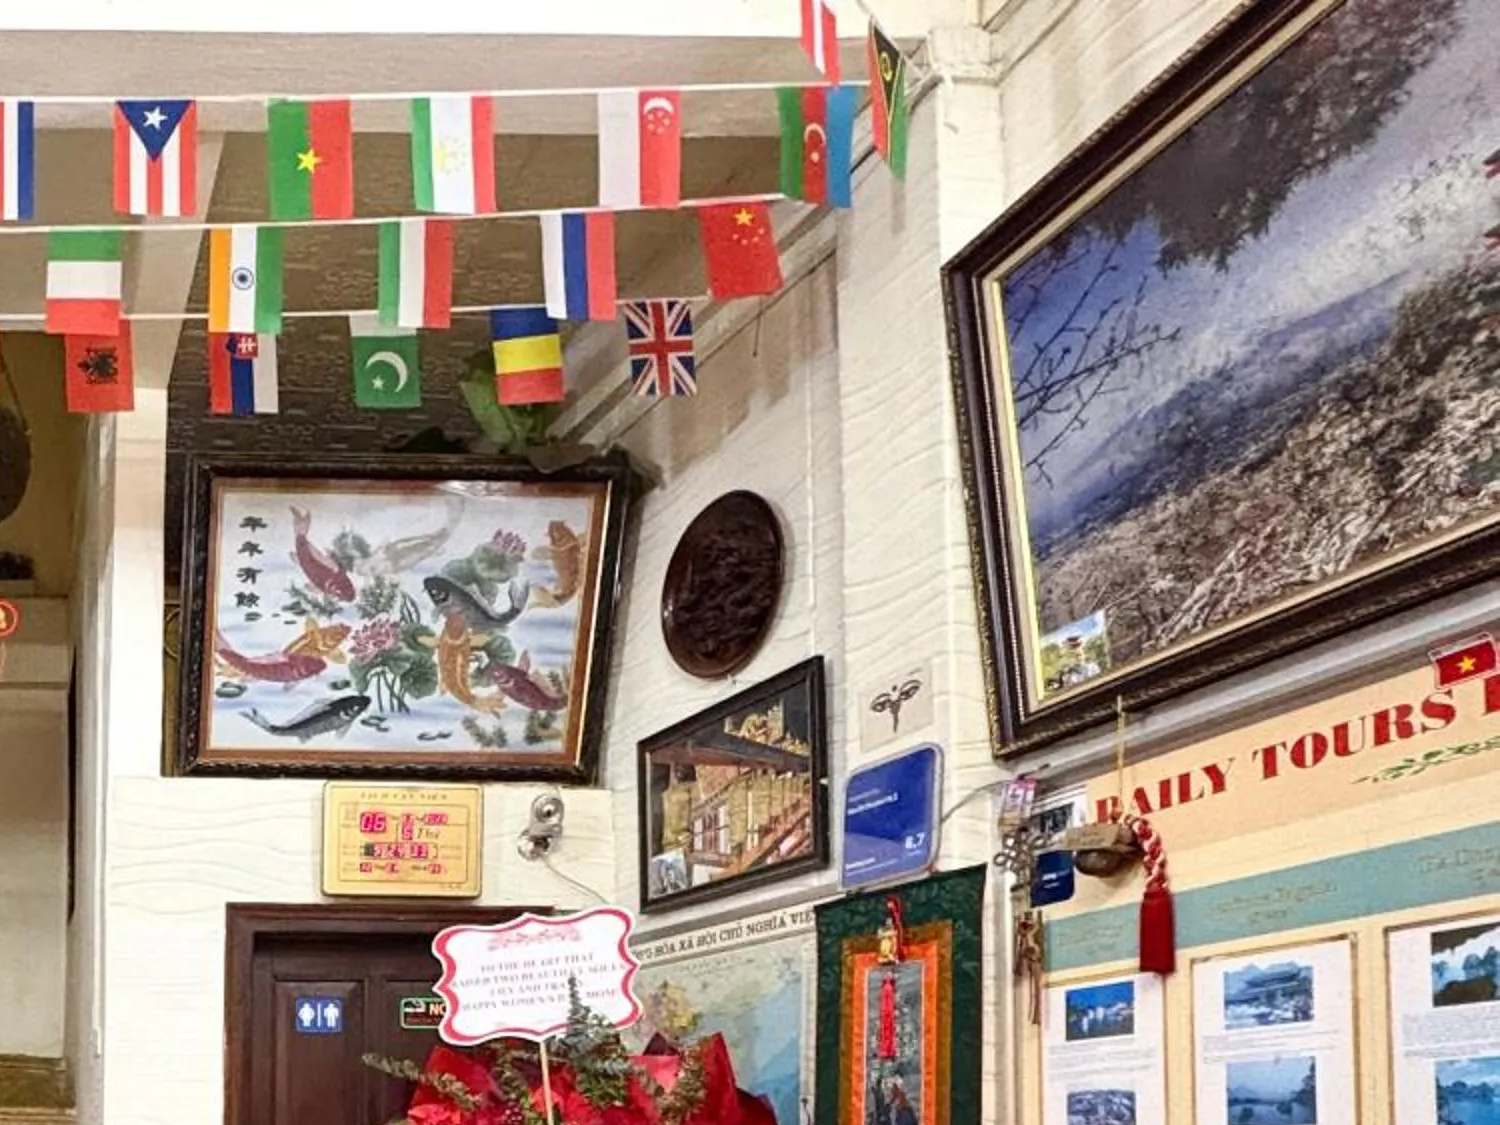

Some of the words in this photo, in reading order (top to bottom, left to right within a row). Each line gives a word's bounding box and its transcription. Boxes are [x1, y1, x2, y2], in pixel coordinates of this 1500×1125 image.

[1095, 757, 1235, 826] DAILY
[1252, 689, 1457, 781] TOURS
[790, 909, 814, 926] VIỆ
